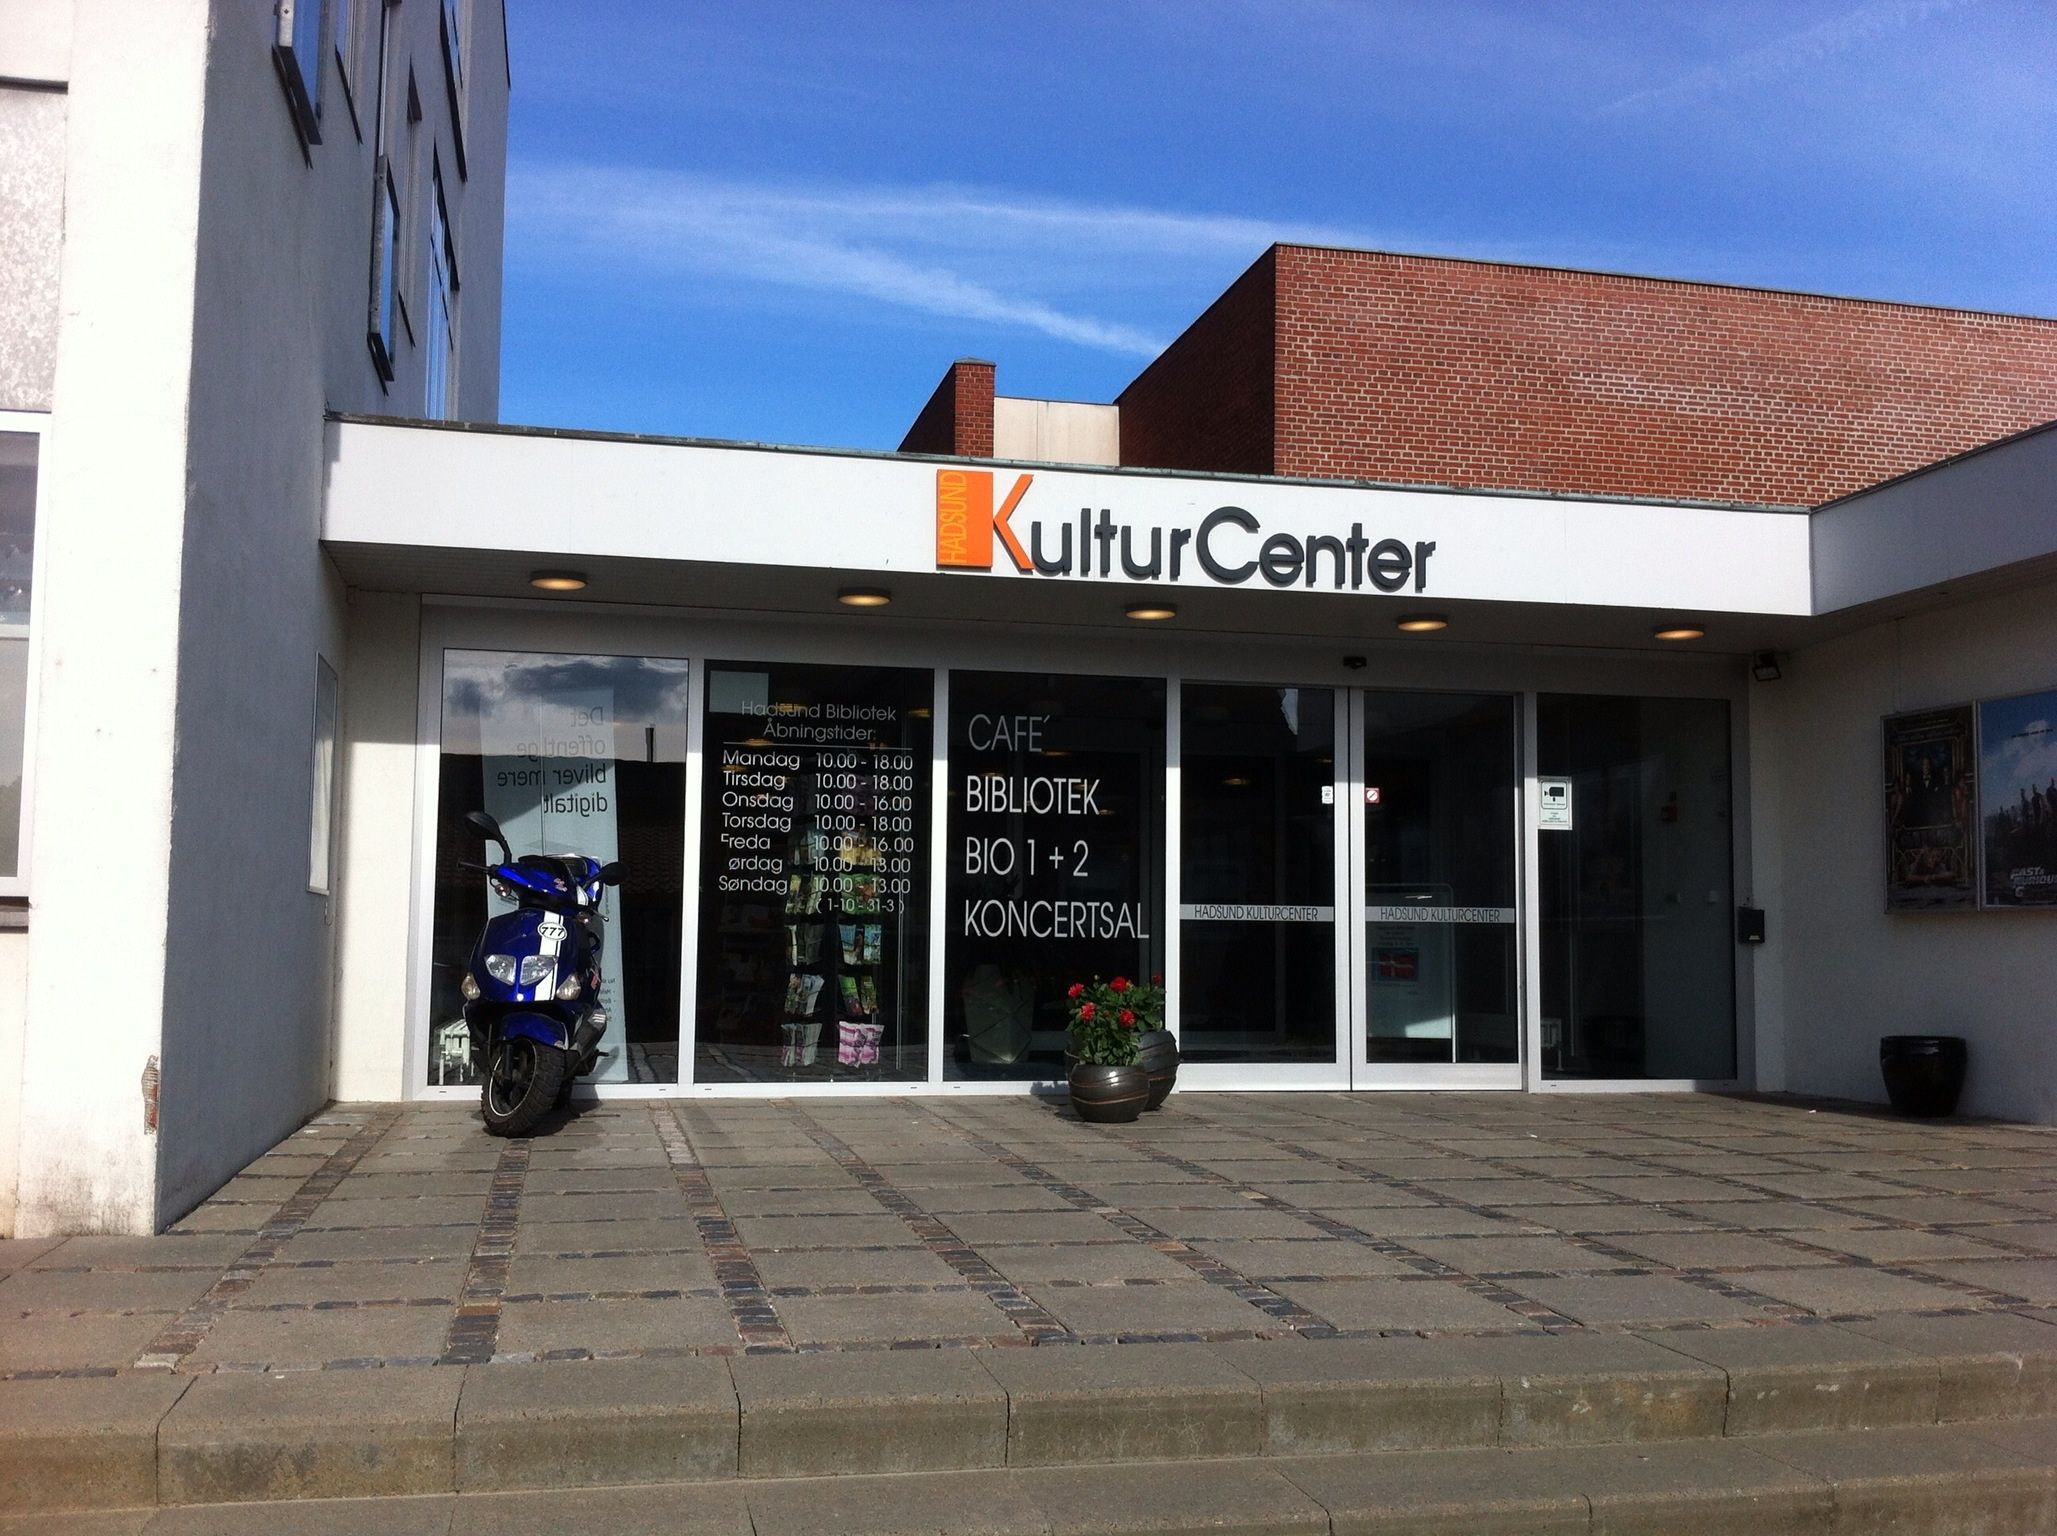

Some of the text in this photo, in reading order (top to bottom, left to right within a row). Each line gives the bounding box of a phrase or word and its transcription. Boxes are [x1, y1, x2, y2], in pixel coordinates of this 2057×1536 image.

[939, 471, 968, 564] HADSUND
[937, 469, 1436, 592] KulturCenter
[741, 701, 897, 721] Hadsund Bibliotek
[763, 718, 876, 742] Åbningstider:
[722, 750, 800, 769] Mandag
[815, 753, 857, 768] 10.00
[873, 754, 913, 770] 18.00
[723, 770, 786, 790] Tirsdag
[815, 773, 857, 789] 10.00
[872, 775, 913, 791] 18.00
[722, 791, 794, 811] Onsdag
[815, 794, 855, 810] 10.00
[872, 796, 912, 811] 16.00
[967, 775, 1100, 815] BIBLIOTEK
[722, 812, 792, 832] Torsdag
[814, 815, 856, 831] 10.00
[871, 816, 912, 832] 18.00
[813, 836, 853, 851] 10.00
[872, 837, 914, 853] 16.00
[813, 856, 853, 872] 10.00
[965, 837, 1015, 875] BIO
[1027, 839, 1035, 876] 1
[1073, 840, 1089, 877] 2
[718, 875, 788, 896] Søndag
[813, 877, 853, 893] 10.00
[872, 878, 911, 894] 13.00
[965, 899, 1150, 938] KONCERTSAL
[1194, 905, 1319, 921] HADSUND KULTURCENTER
[1380, 907, 1500, 922] HADSUND KULTURCENTER
[541, 926, 564, 937] 777
